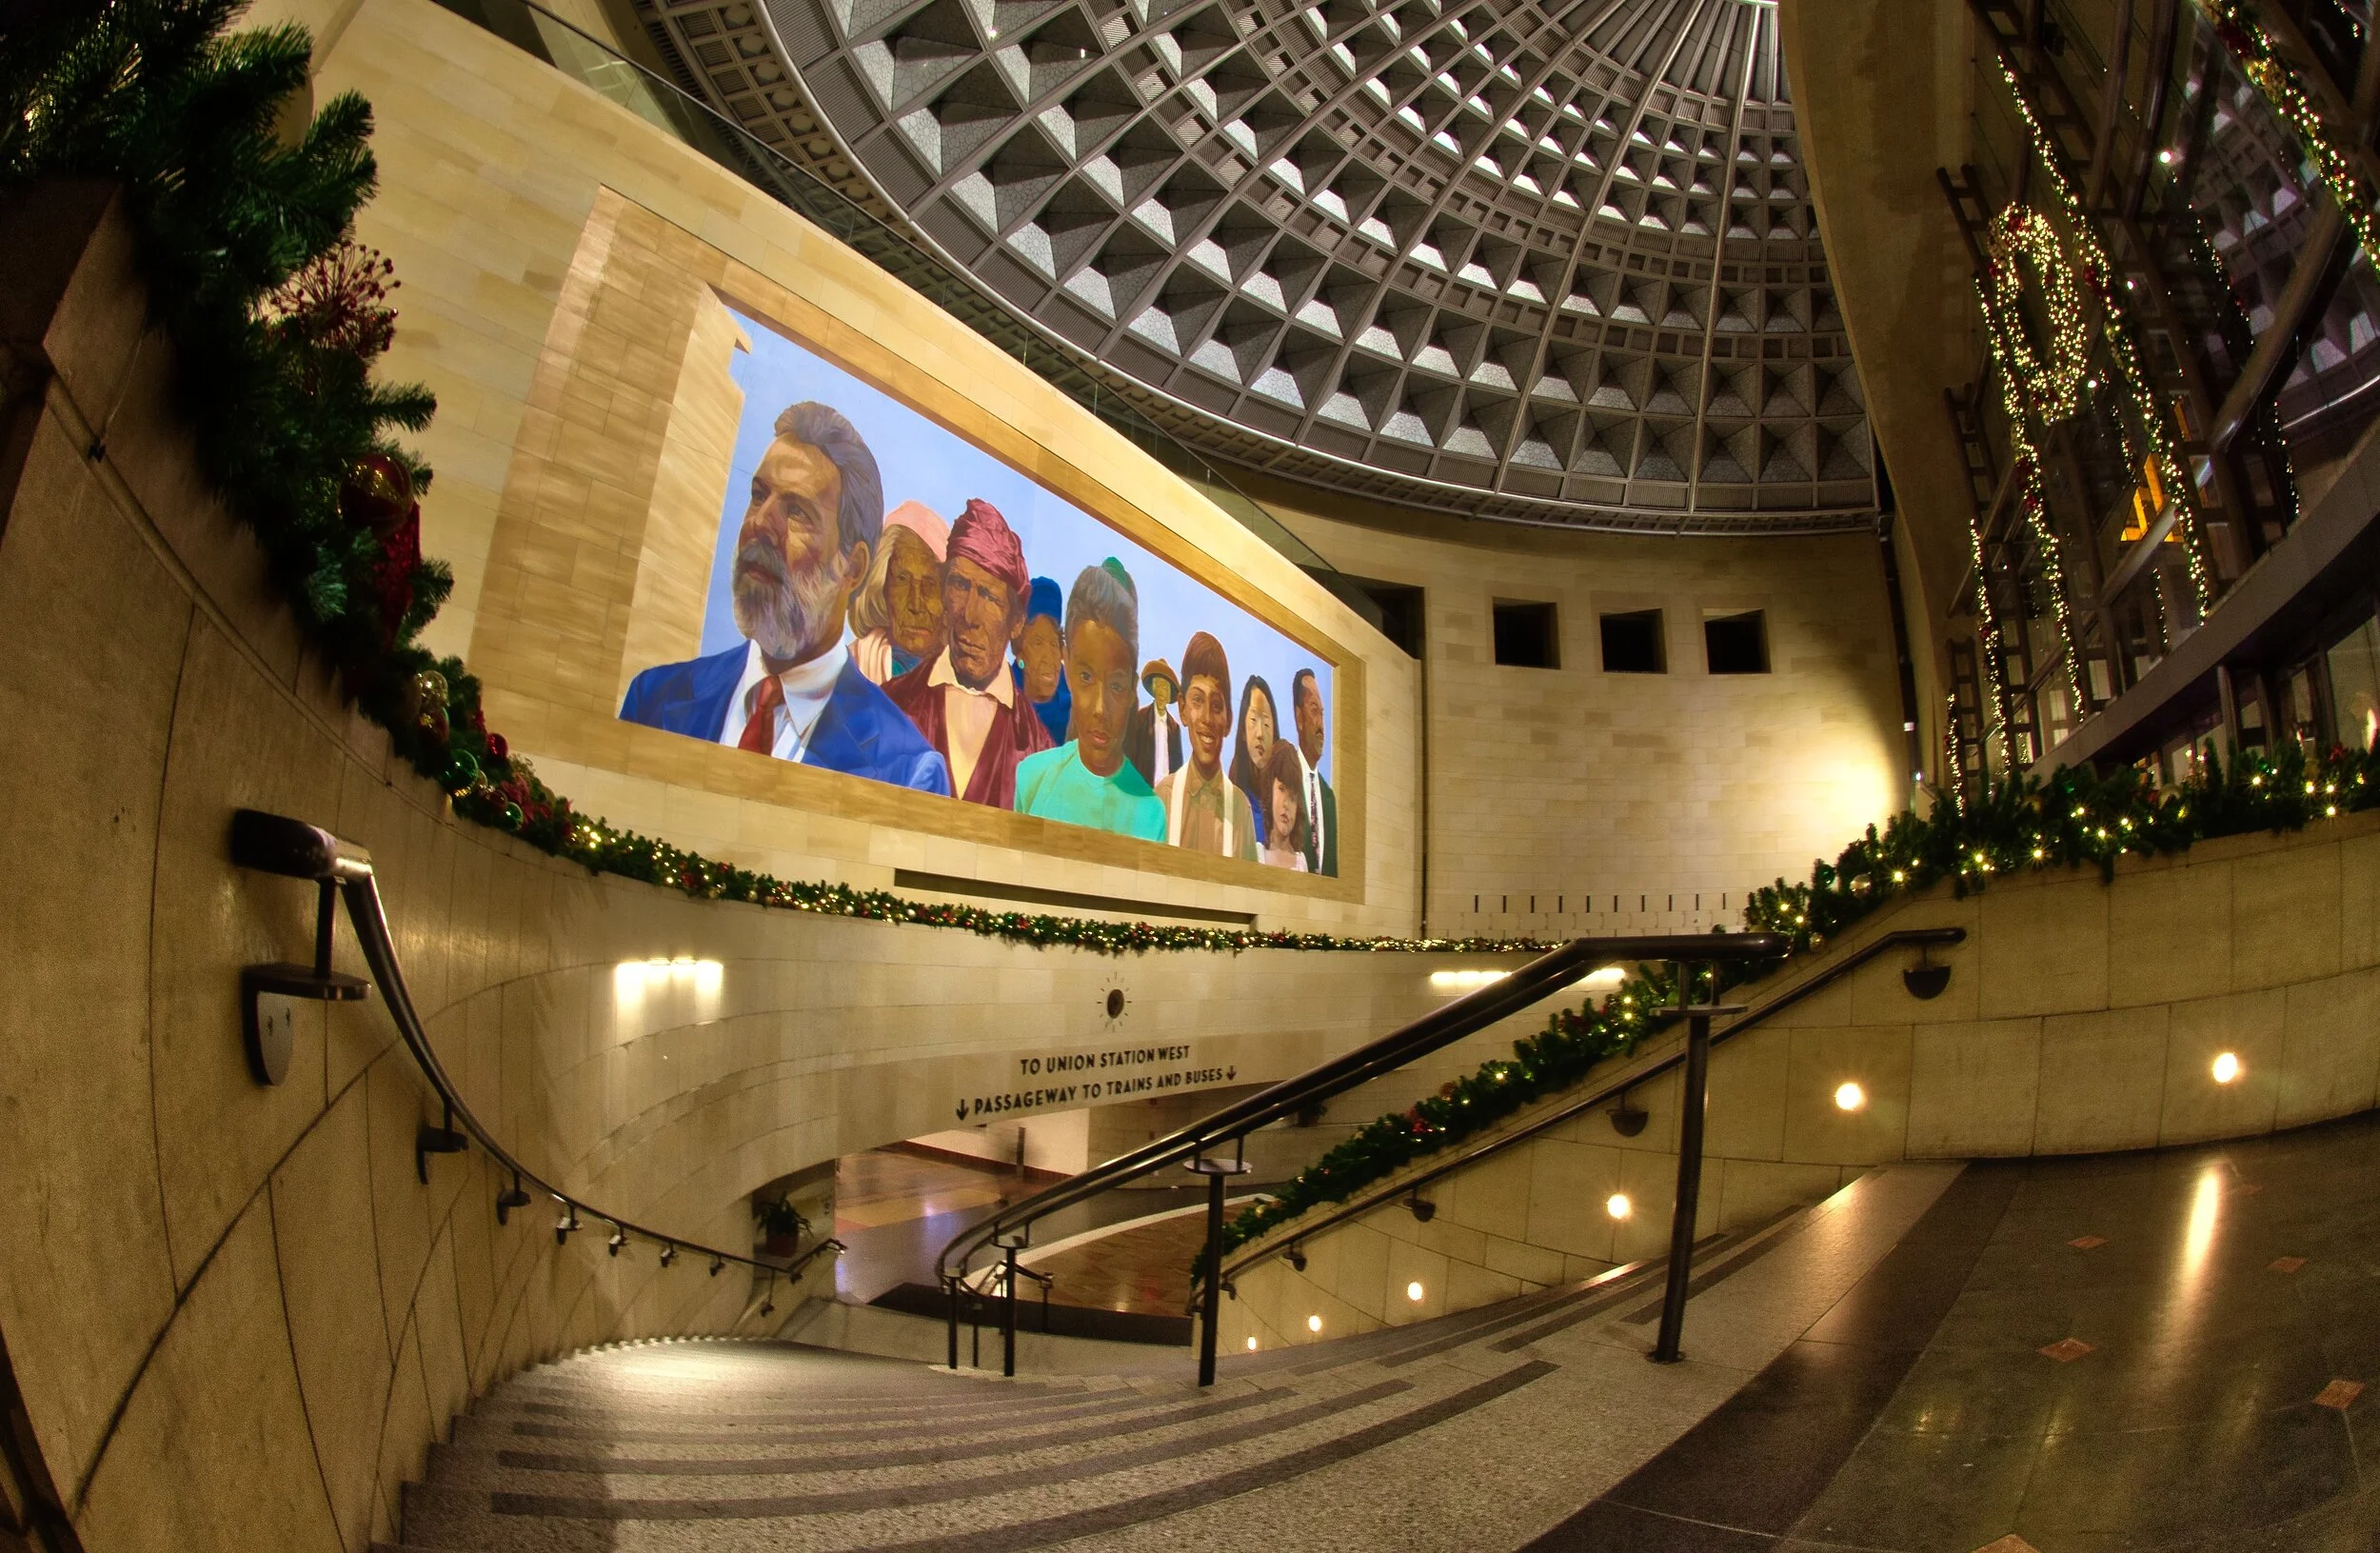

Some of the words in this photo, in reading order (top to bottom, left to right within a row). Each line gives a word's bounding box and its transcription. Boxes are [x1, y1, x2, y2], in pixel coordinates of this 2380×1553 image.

[1021, 1059, 1041, 1075] TO
[1046, 1054, 1095, 1074] UNION
[1100, 1048, 1155, 1067] STATION
[1158, 1045, 1190, 1061] WEST
[974, 1085, 1078, 1115] PASSAGEWAY
[1082, 1083, 1101, 1099] TO
[1106, 1077, 1153, 1095] TRAINS
[1157, 1073, 1181, 1087] AND
[1186, 1067, 1223, 1085] BUSES
